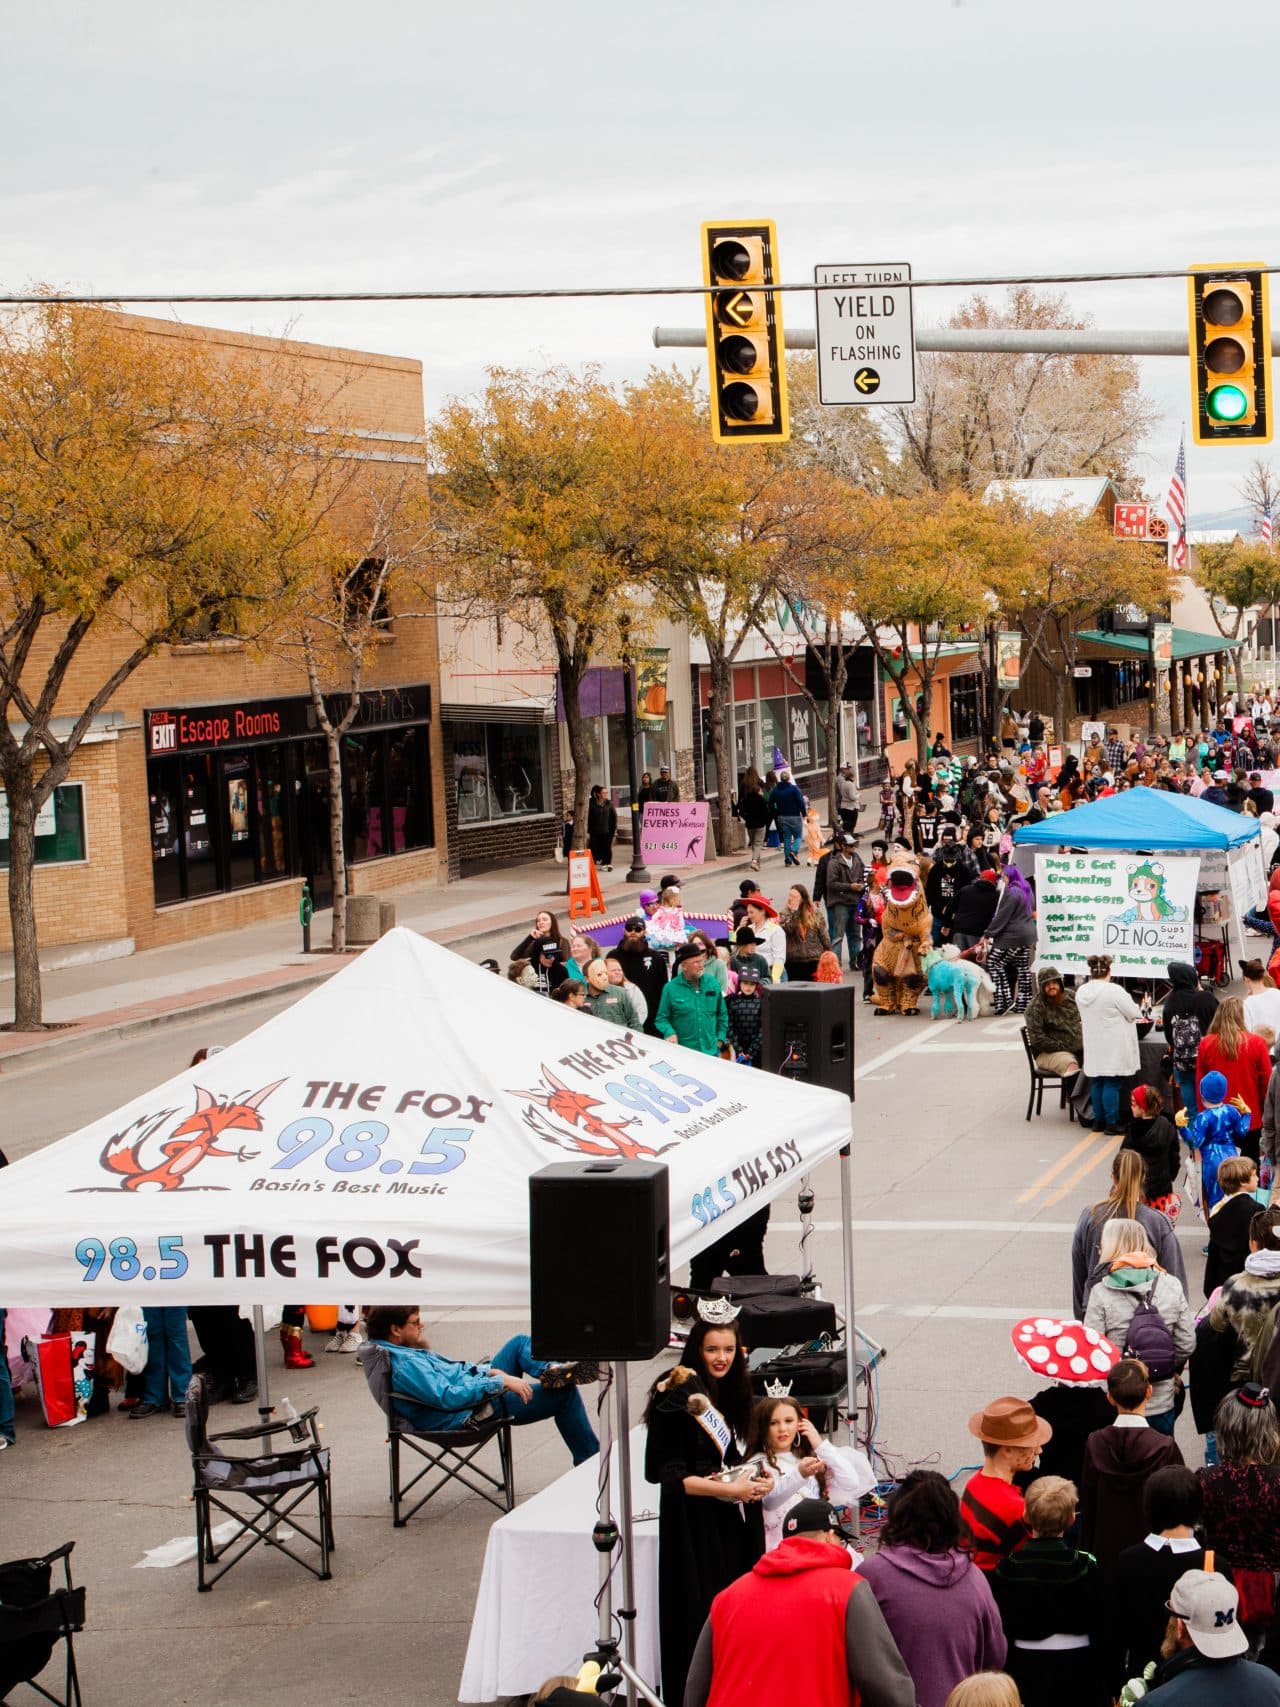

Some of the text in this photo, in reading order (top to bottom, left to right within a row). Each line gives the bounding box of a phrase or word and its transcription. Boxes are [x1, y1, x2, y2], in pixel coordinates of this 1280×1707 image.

[834, 296, 895, 318] YIELD
[855, 325, 875, 340] ON
[831, 345, 901, 361] FLASHING
[152, 723, 176, 750] EXIT
[180, 710, 280, 747] Escape Rooms
[647, 807, 697, 817] FITNESS 4
[643, 818, 675, 828] EVERY
[920, 823, 934, 840] 17
[1045, 859, 1116, 871] Dog & Cat
[1047, 873, 1112, 887] Grooming
[1106, 923, 1159, 946] DINO
[1120, 954, 1147, 965] Book
[558, 1031, 649, 1080] THE FOX
[302, 1080, 494, 1124] THE FOX
[605, 1060, 718, 1124] 98.5
[270, 1116, 475, 1176] 98.5
[250, 1178, 449, 1196] Basin's Best Music
[691, 1175, 737, 1228] 98.5
[731, 1156, 769, 1200] THE
[75, 1233, 423, 1283] 98.5 THE FOX
[1214, 1608, 1235, 1628] M
